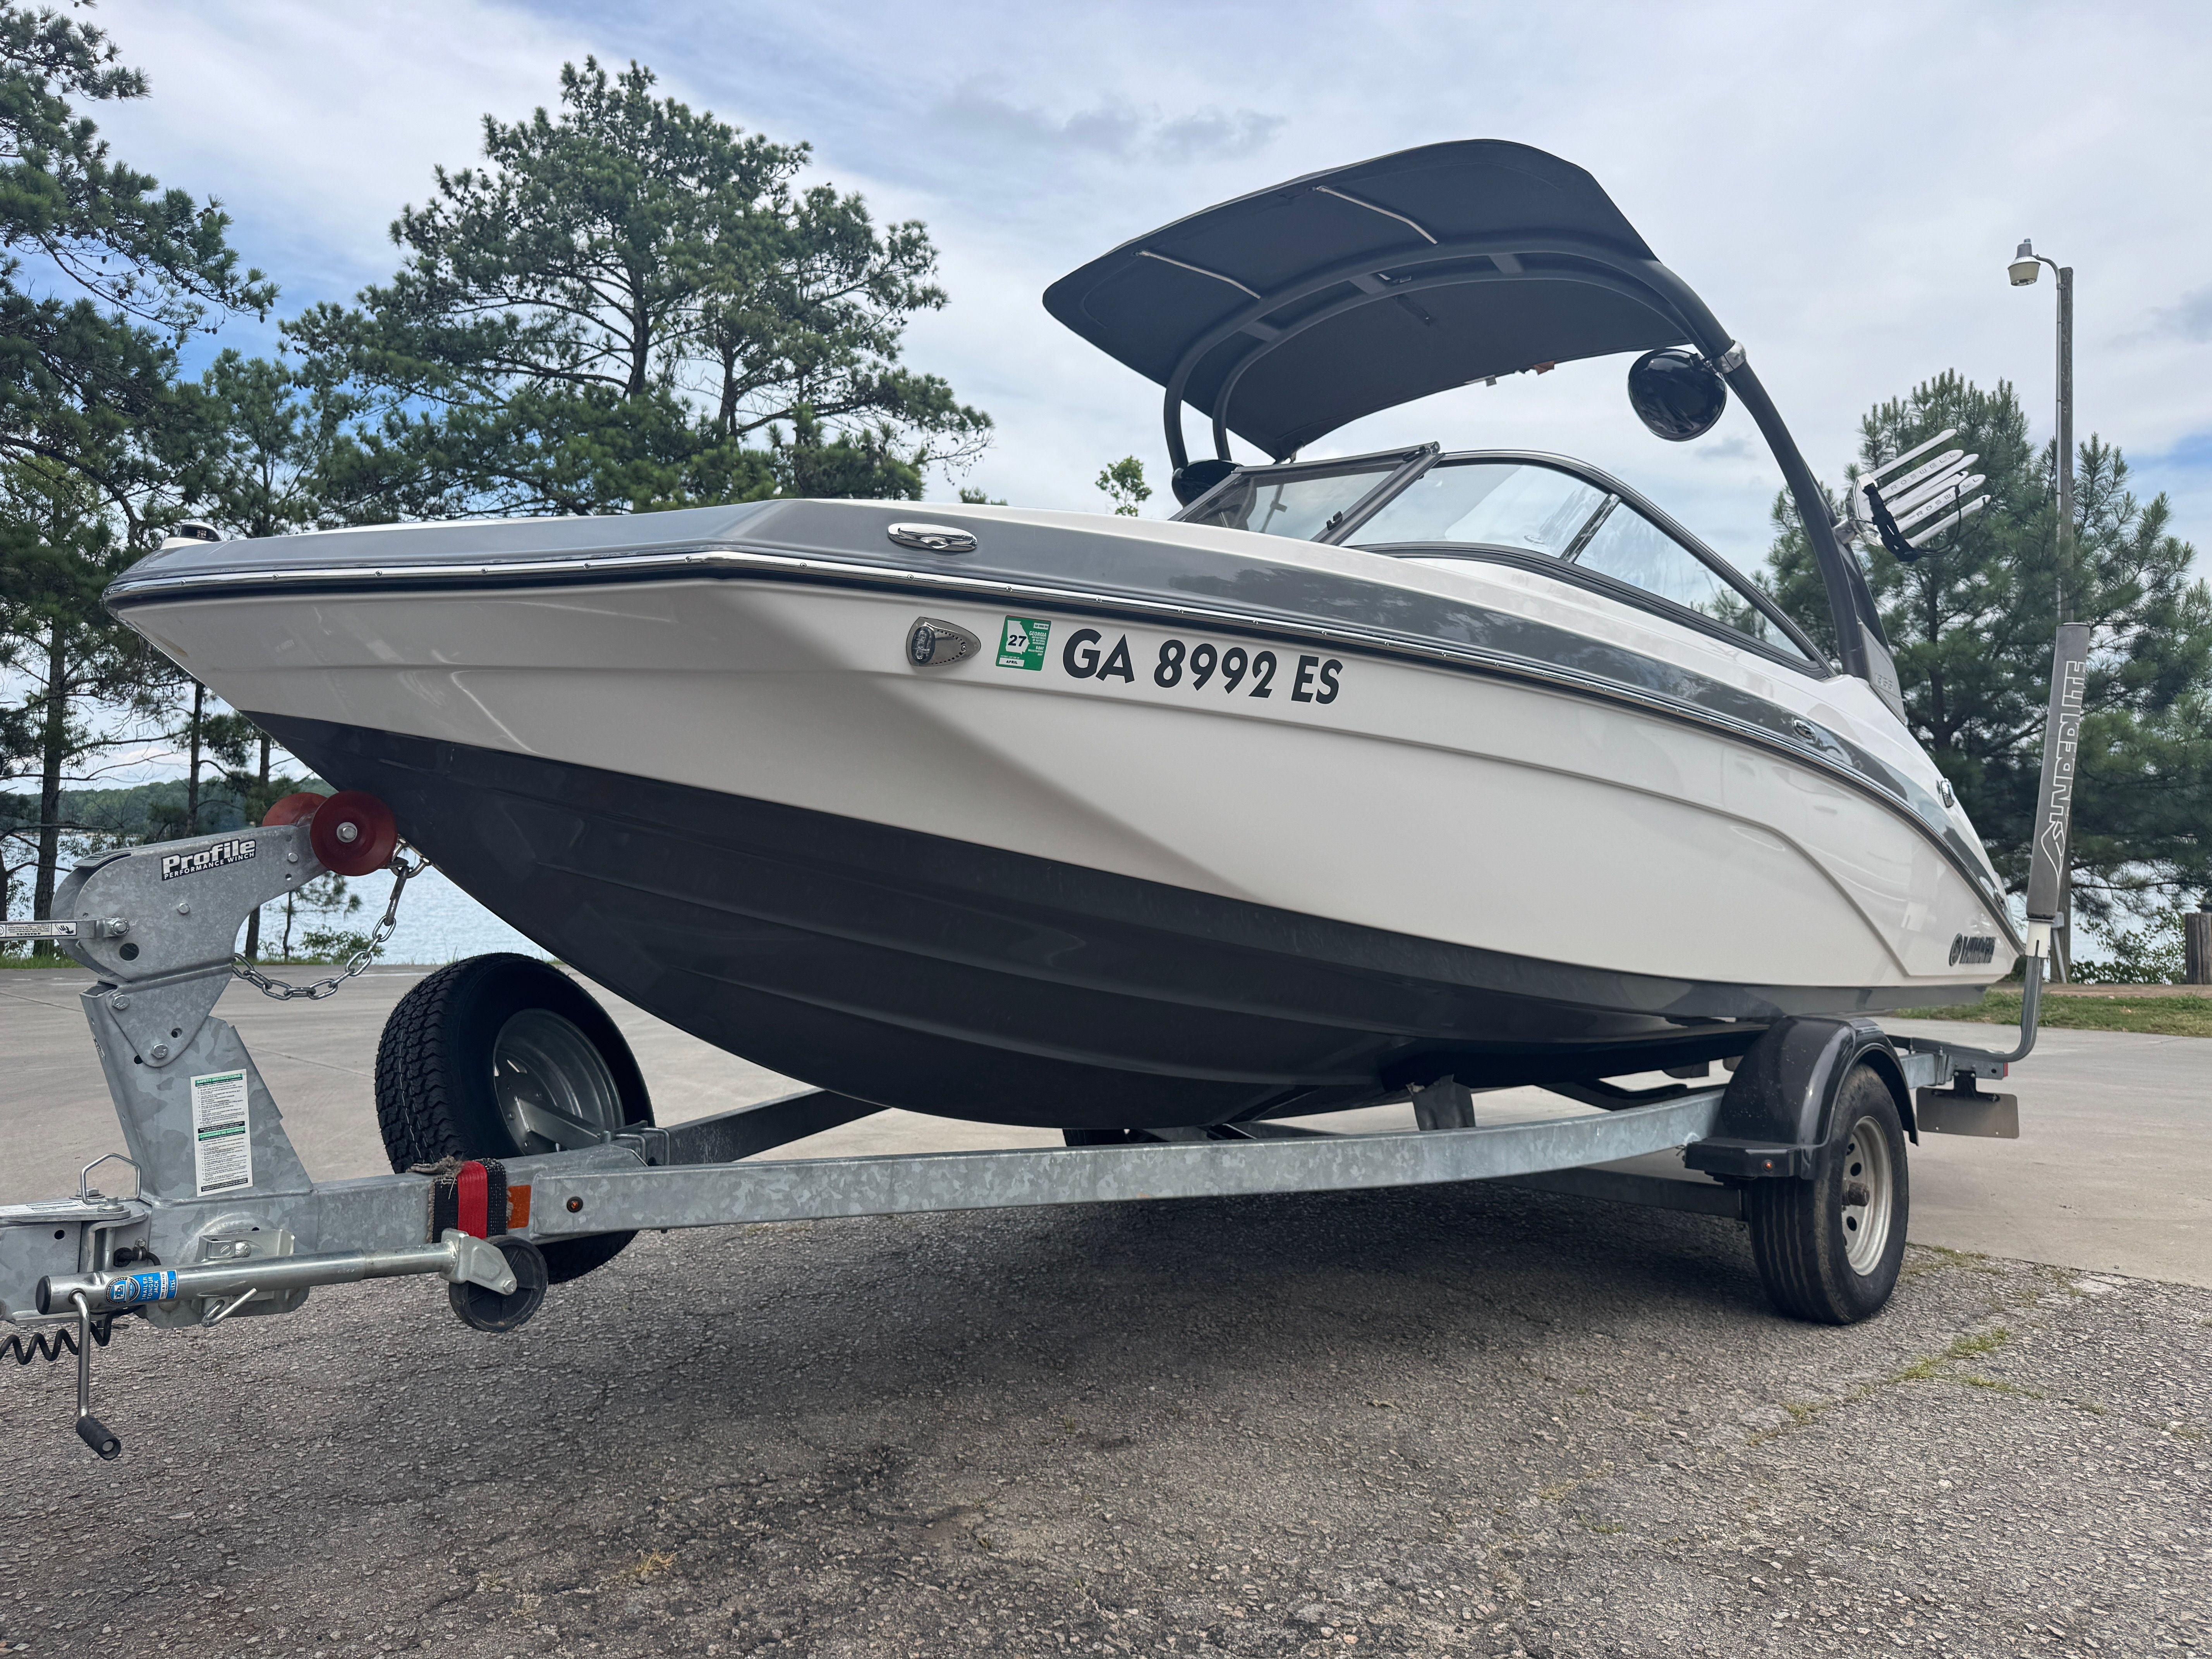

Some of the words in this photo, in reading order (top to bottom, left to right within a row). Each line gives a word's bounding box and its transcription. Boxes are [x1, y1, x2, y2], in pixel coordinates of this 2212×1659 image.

[1916, 477, 1980, 517] ROSWLL
[1008, 635, 1027, 647] 27
[1063, 628, 1135, 684] GA
[1154, 639, 1277, 698] 8992
[1291, 655, 1343, 704] ES
[163, 840, 255, 874] Profile
[164, 859, 224, 879] PERFORMANCE
[227, 852, 254, 863] WINCH
